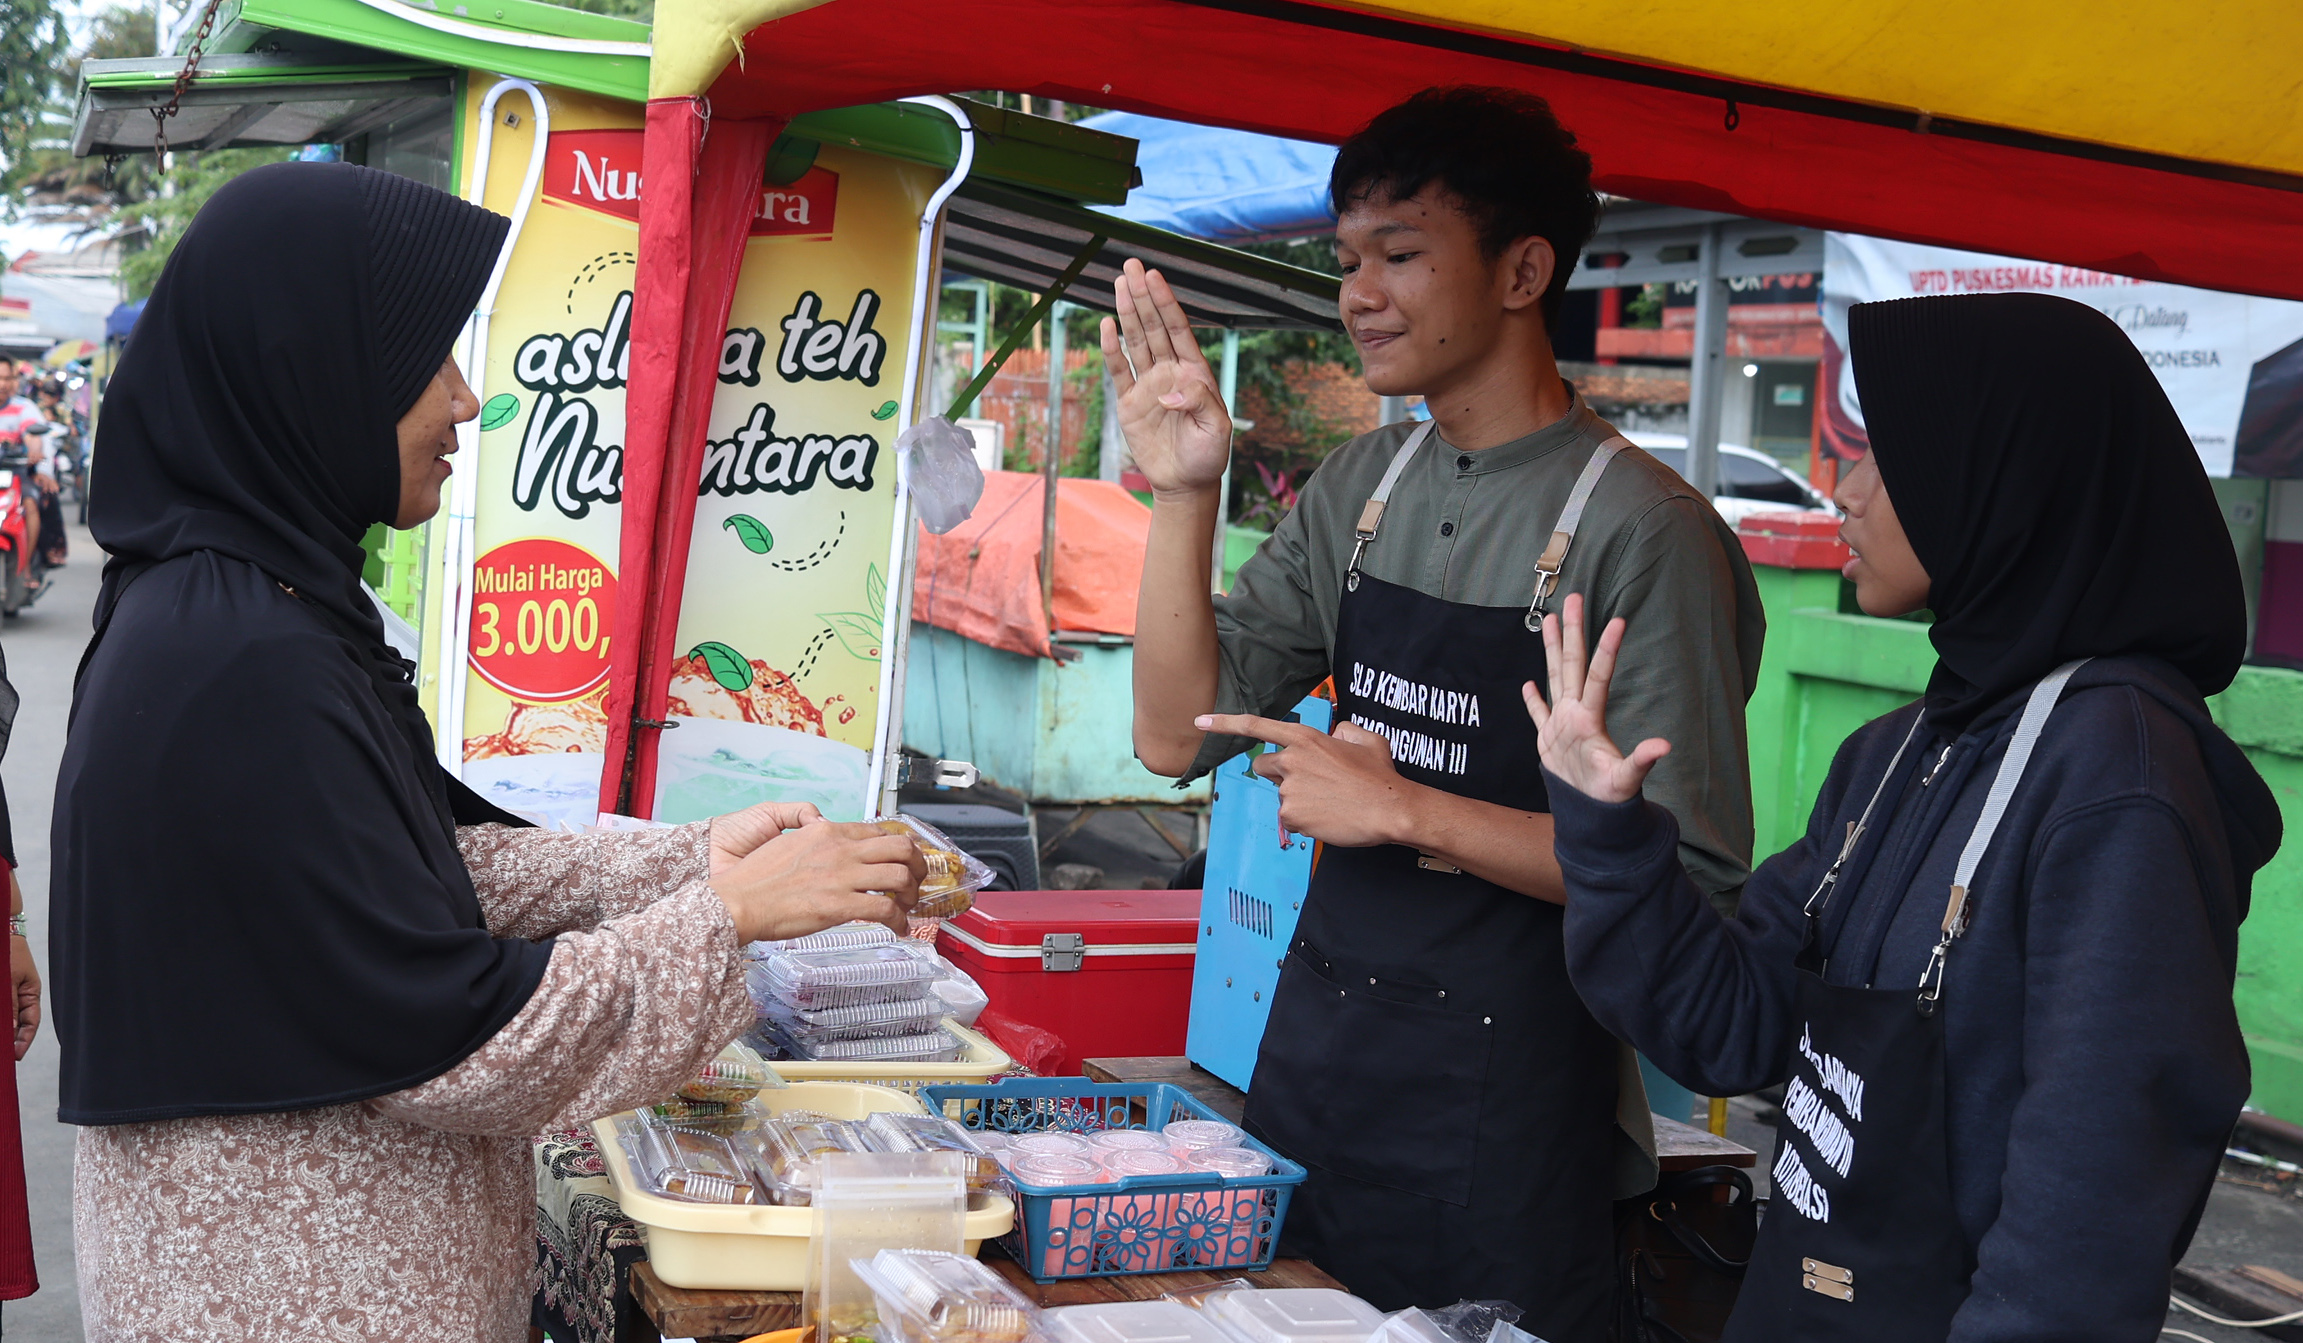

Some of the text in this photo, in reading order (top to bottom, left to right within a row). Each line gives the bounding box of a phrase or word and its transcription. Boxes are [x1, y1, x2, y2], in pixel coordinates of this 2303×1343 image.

[1909, 270, 1948, 293] UPTD
[1953, 265, 2055, 291] PUSKESMAS
[776, 288, 887, 387] teh
[475, 563, 604, 596] Mulai Harga
[475, 597, 611, 659] 3.000,
[1350, 661, 1481, 728] SLB KEMBAR KARYA
[1448, 741, 1468, 776] III
